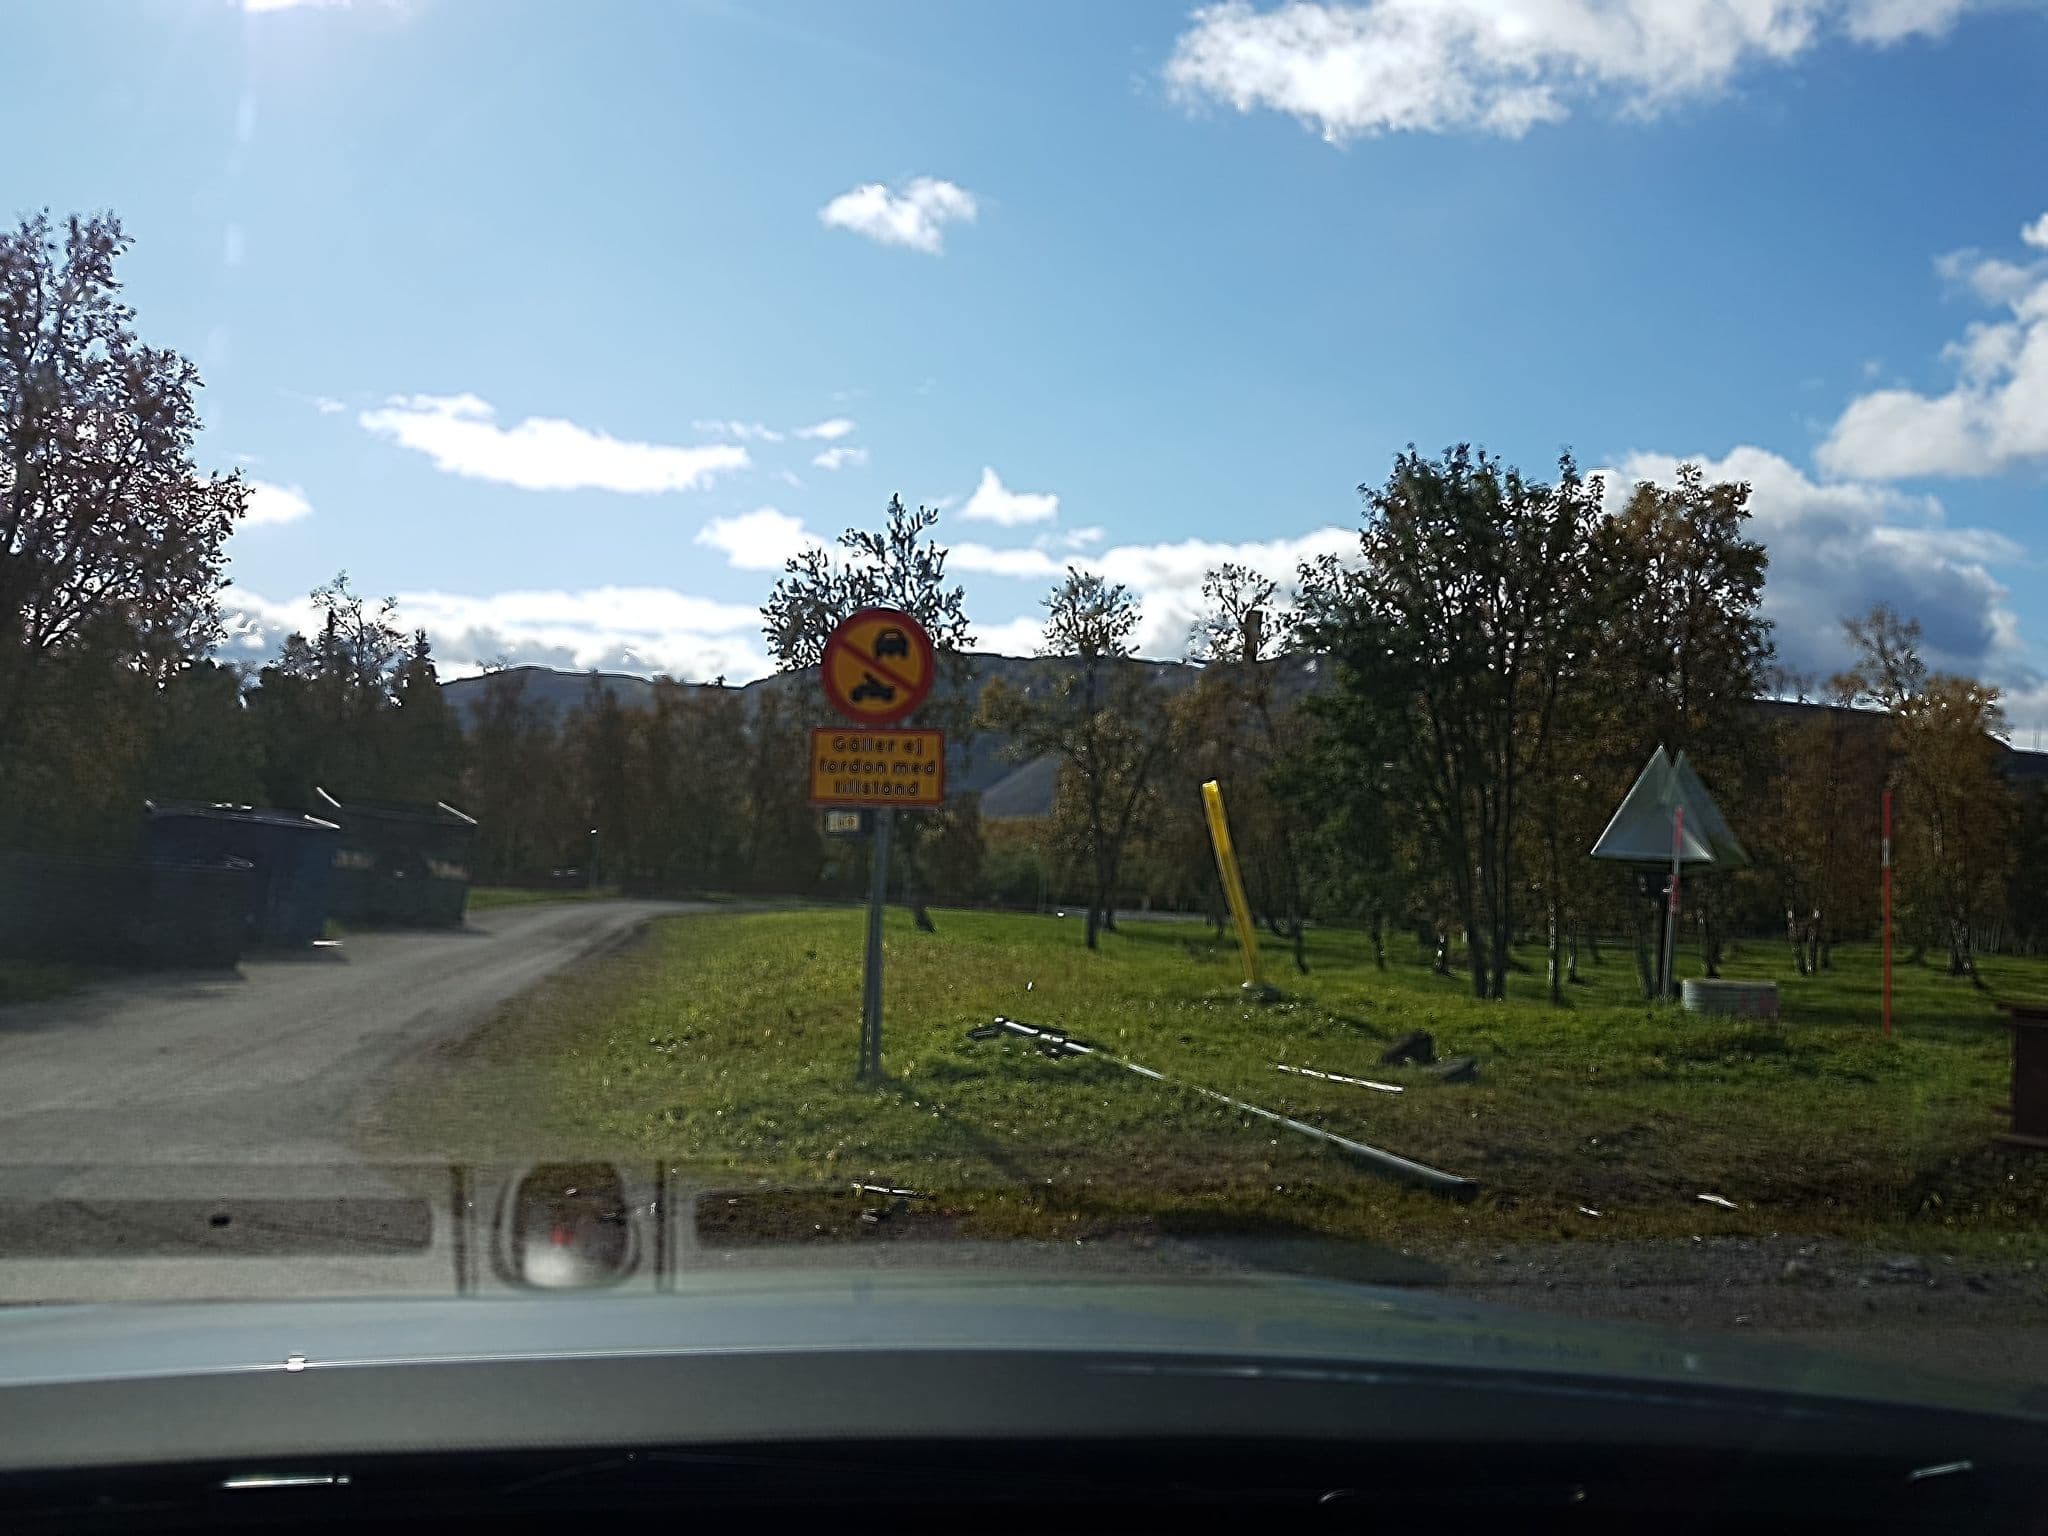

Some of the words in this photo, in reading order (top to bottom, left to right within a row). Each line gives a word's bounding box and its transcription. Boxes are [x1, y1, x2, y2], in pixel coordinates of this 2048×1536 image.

[903, 737, 923, 756] ej
[820, 758, 886, 774] fordon
[893, 759, 936, 774] med
